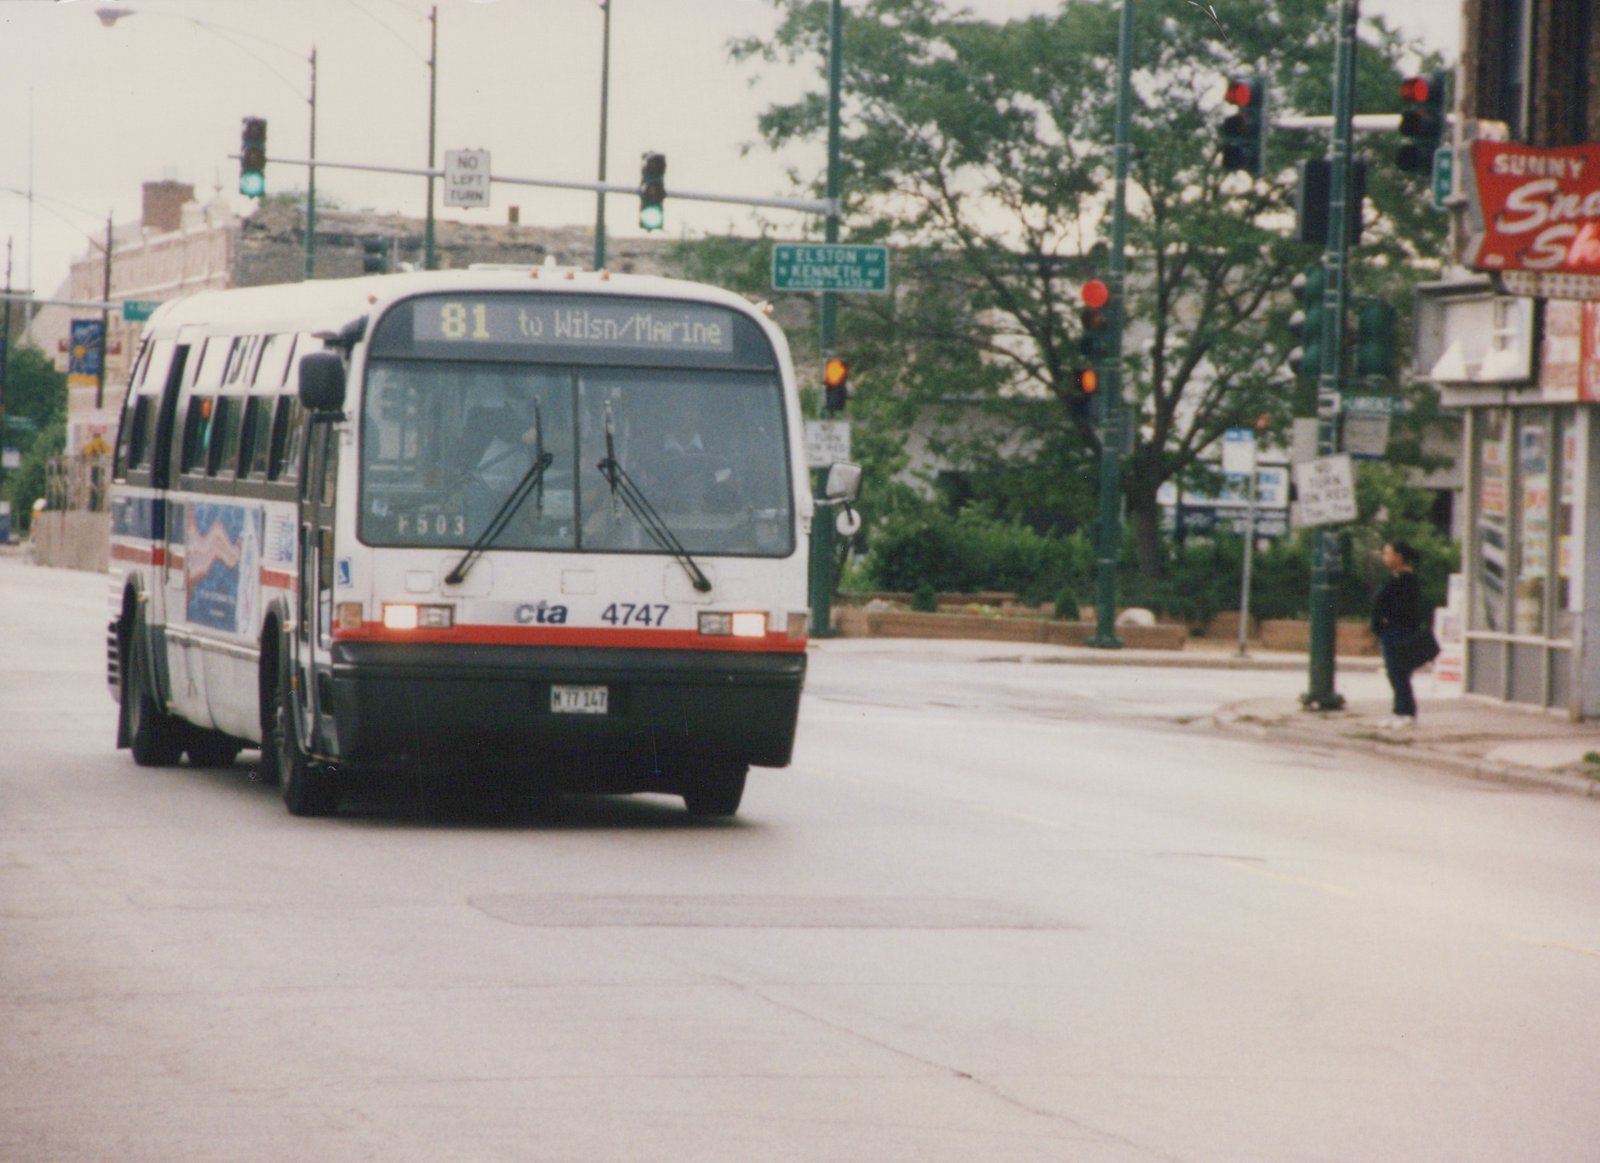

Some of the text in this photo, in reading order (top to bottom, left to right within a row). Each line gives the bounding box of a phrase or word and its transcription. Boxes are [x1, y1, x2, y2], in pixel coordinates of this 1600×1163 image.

[457, 156, 478, 169] NO
[1493, 153, 1585, 179] SUNNY
[452, 174, 482, 185] LEFT
[450, 190, 483, 201] TURN
[796, 248, 857, 263] ELSTON
[791, 265, 861, 279] KENNETH
[441, 303, 721, 345] 81 to Wilsn/Marine
[397, 513, 465, 536] F503
[514, 600, 670, 626] cta 4747
[553, 690, 561, 705] M
[565, 690, 579, 706] 77
